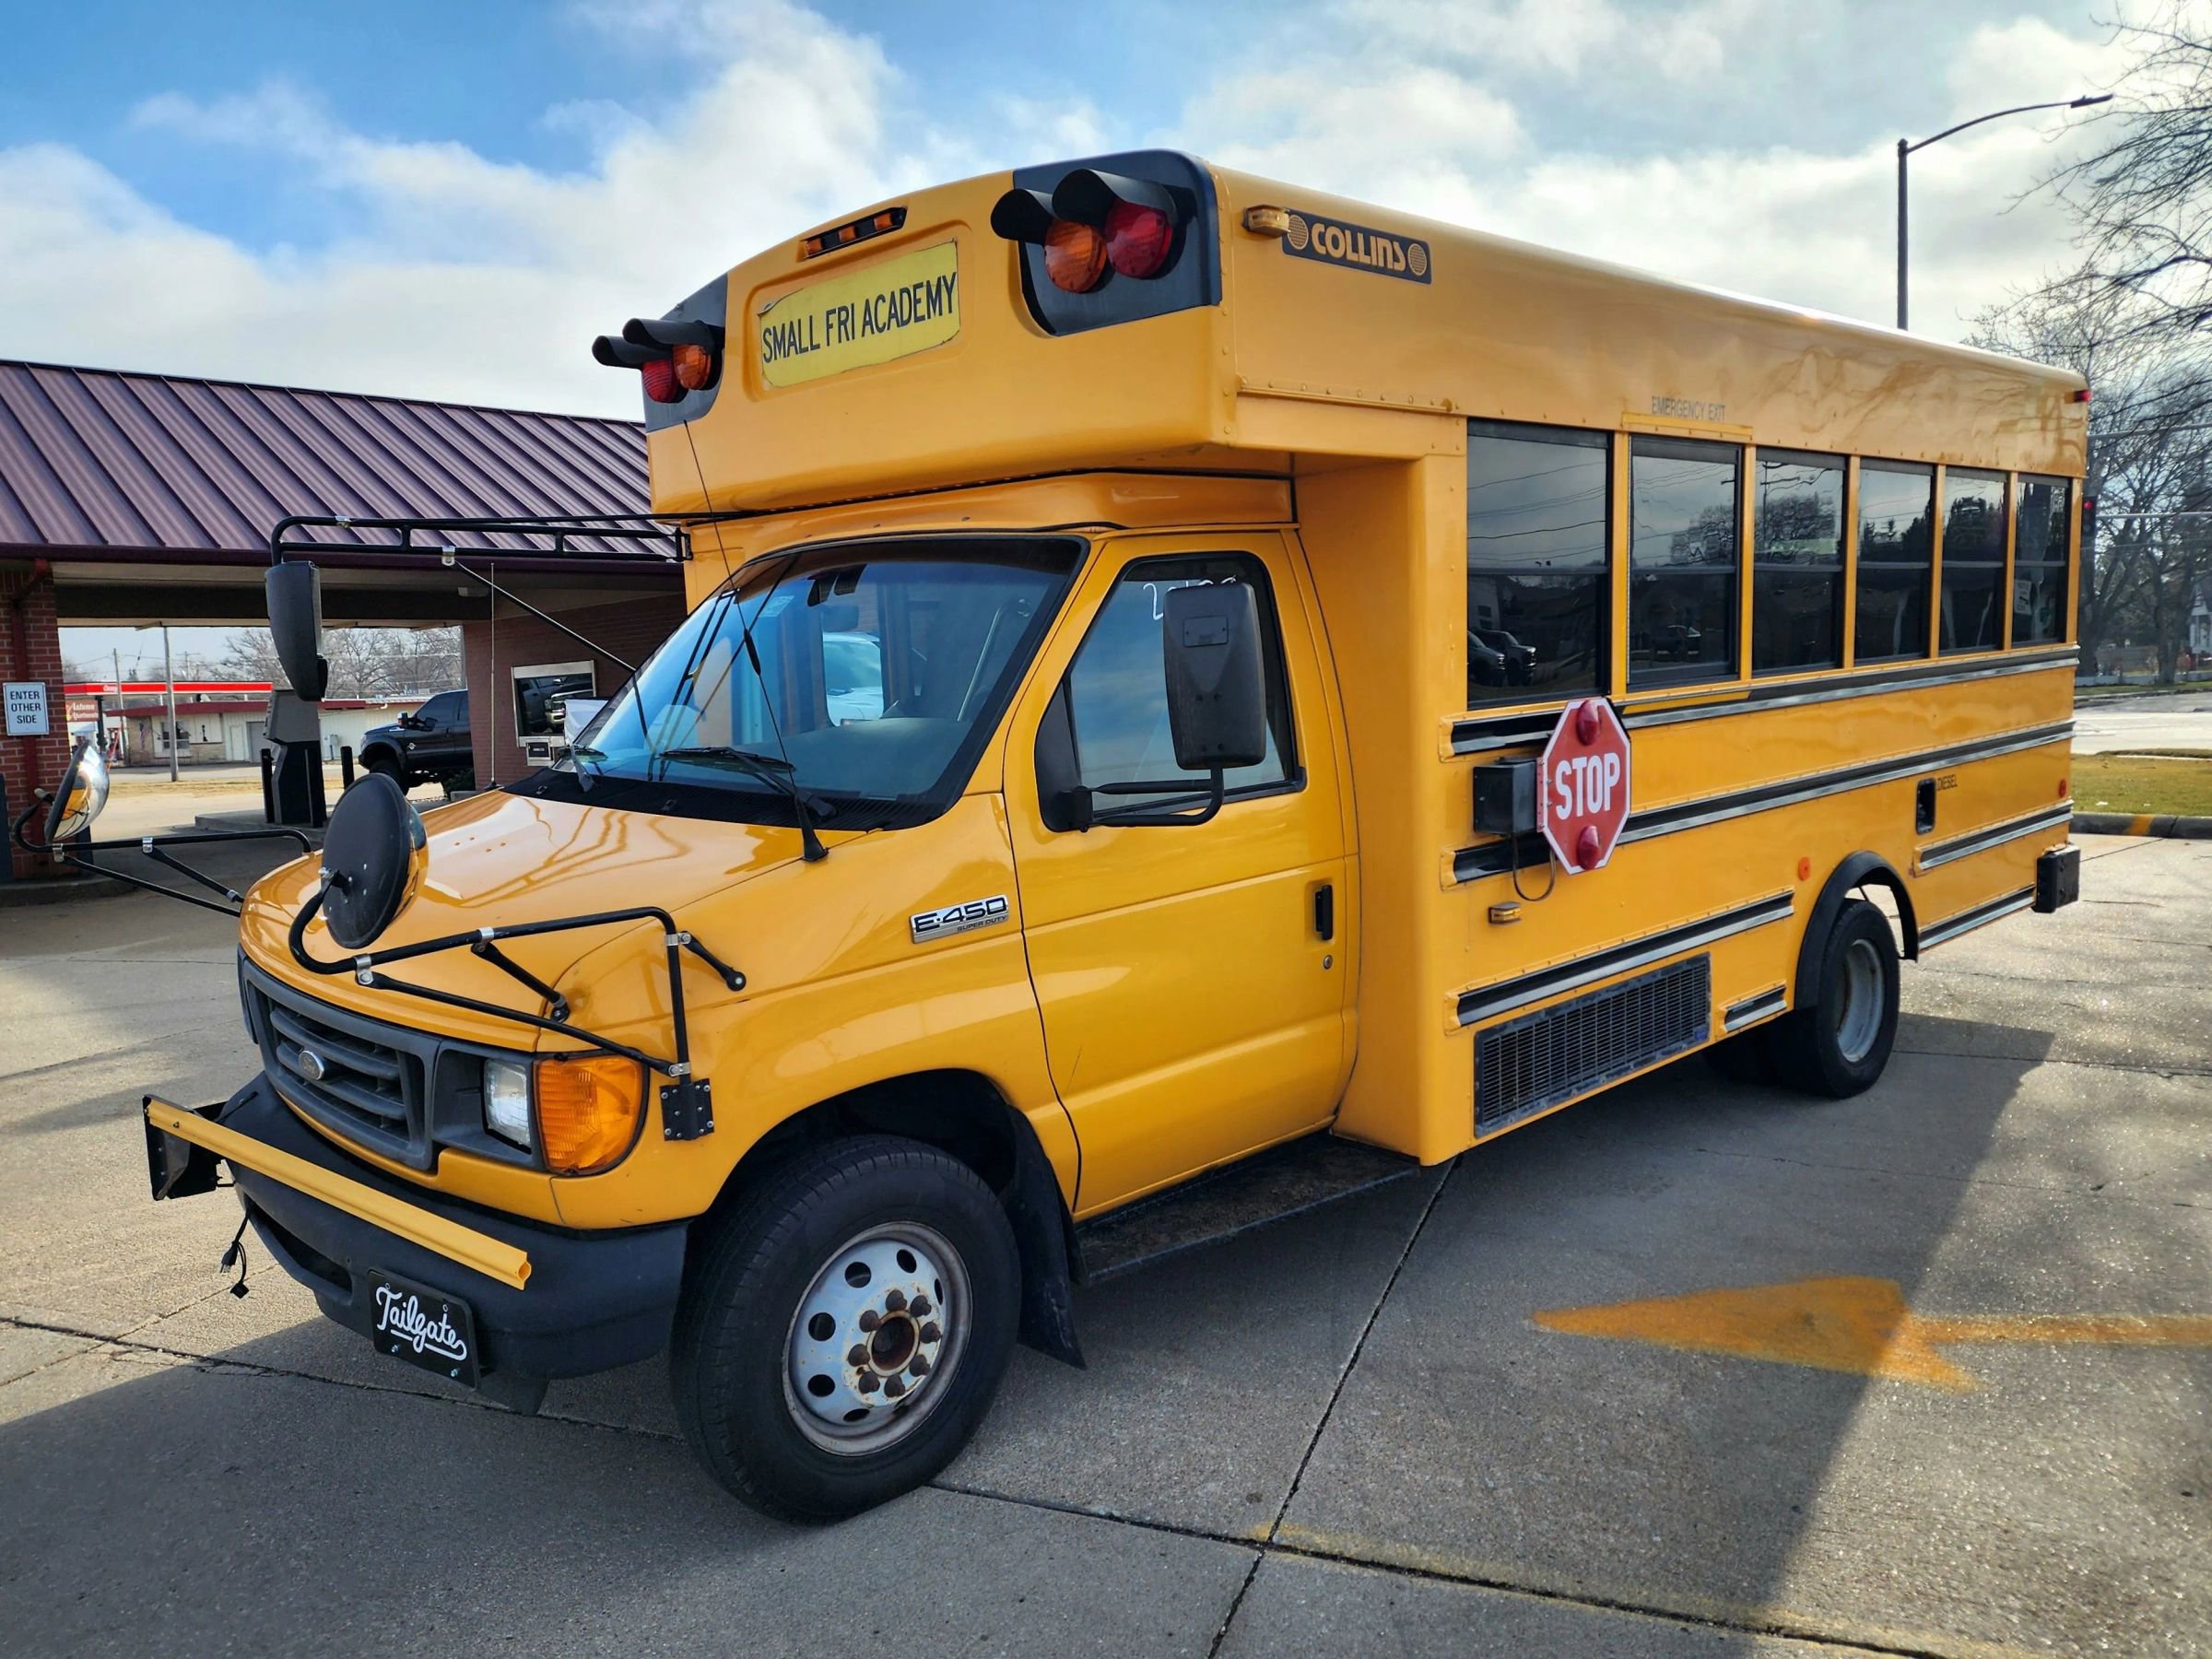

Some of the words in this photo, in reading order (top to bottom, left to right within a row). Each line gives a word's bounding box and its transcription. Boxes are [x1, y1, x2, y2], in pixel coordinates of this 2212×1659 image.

[1312, 223, 1406, 272] COLLINS
[762, 314, 820, 363] SMALL
[826, 302, 855, 347] FRI
[861, 272, 957, 337] ACADEMY
[1652, 395, 1705, 420] EMERGENCY
[1708, 403, 1725, 421] EXIT
[10, 690, 40, 700] ENTER
[11, 703, 41, 712] OTHER
[17, 714, 37, 724] SIDE
[1556, 752, 1620, 820] STOP
[1937, 774, 1958, 792] DIESEL
[914, 897, 1006, 933] E-450
[958, 921, 983, 932] SUPER
[985, 915, 1006, 925] DUTY
[376, 1286, 467, 1360] Tailgate
